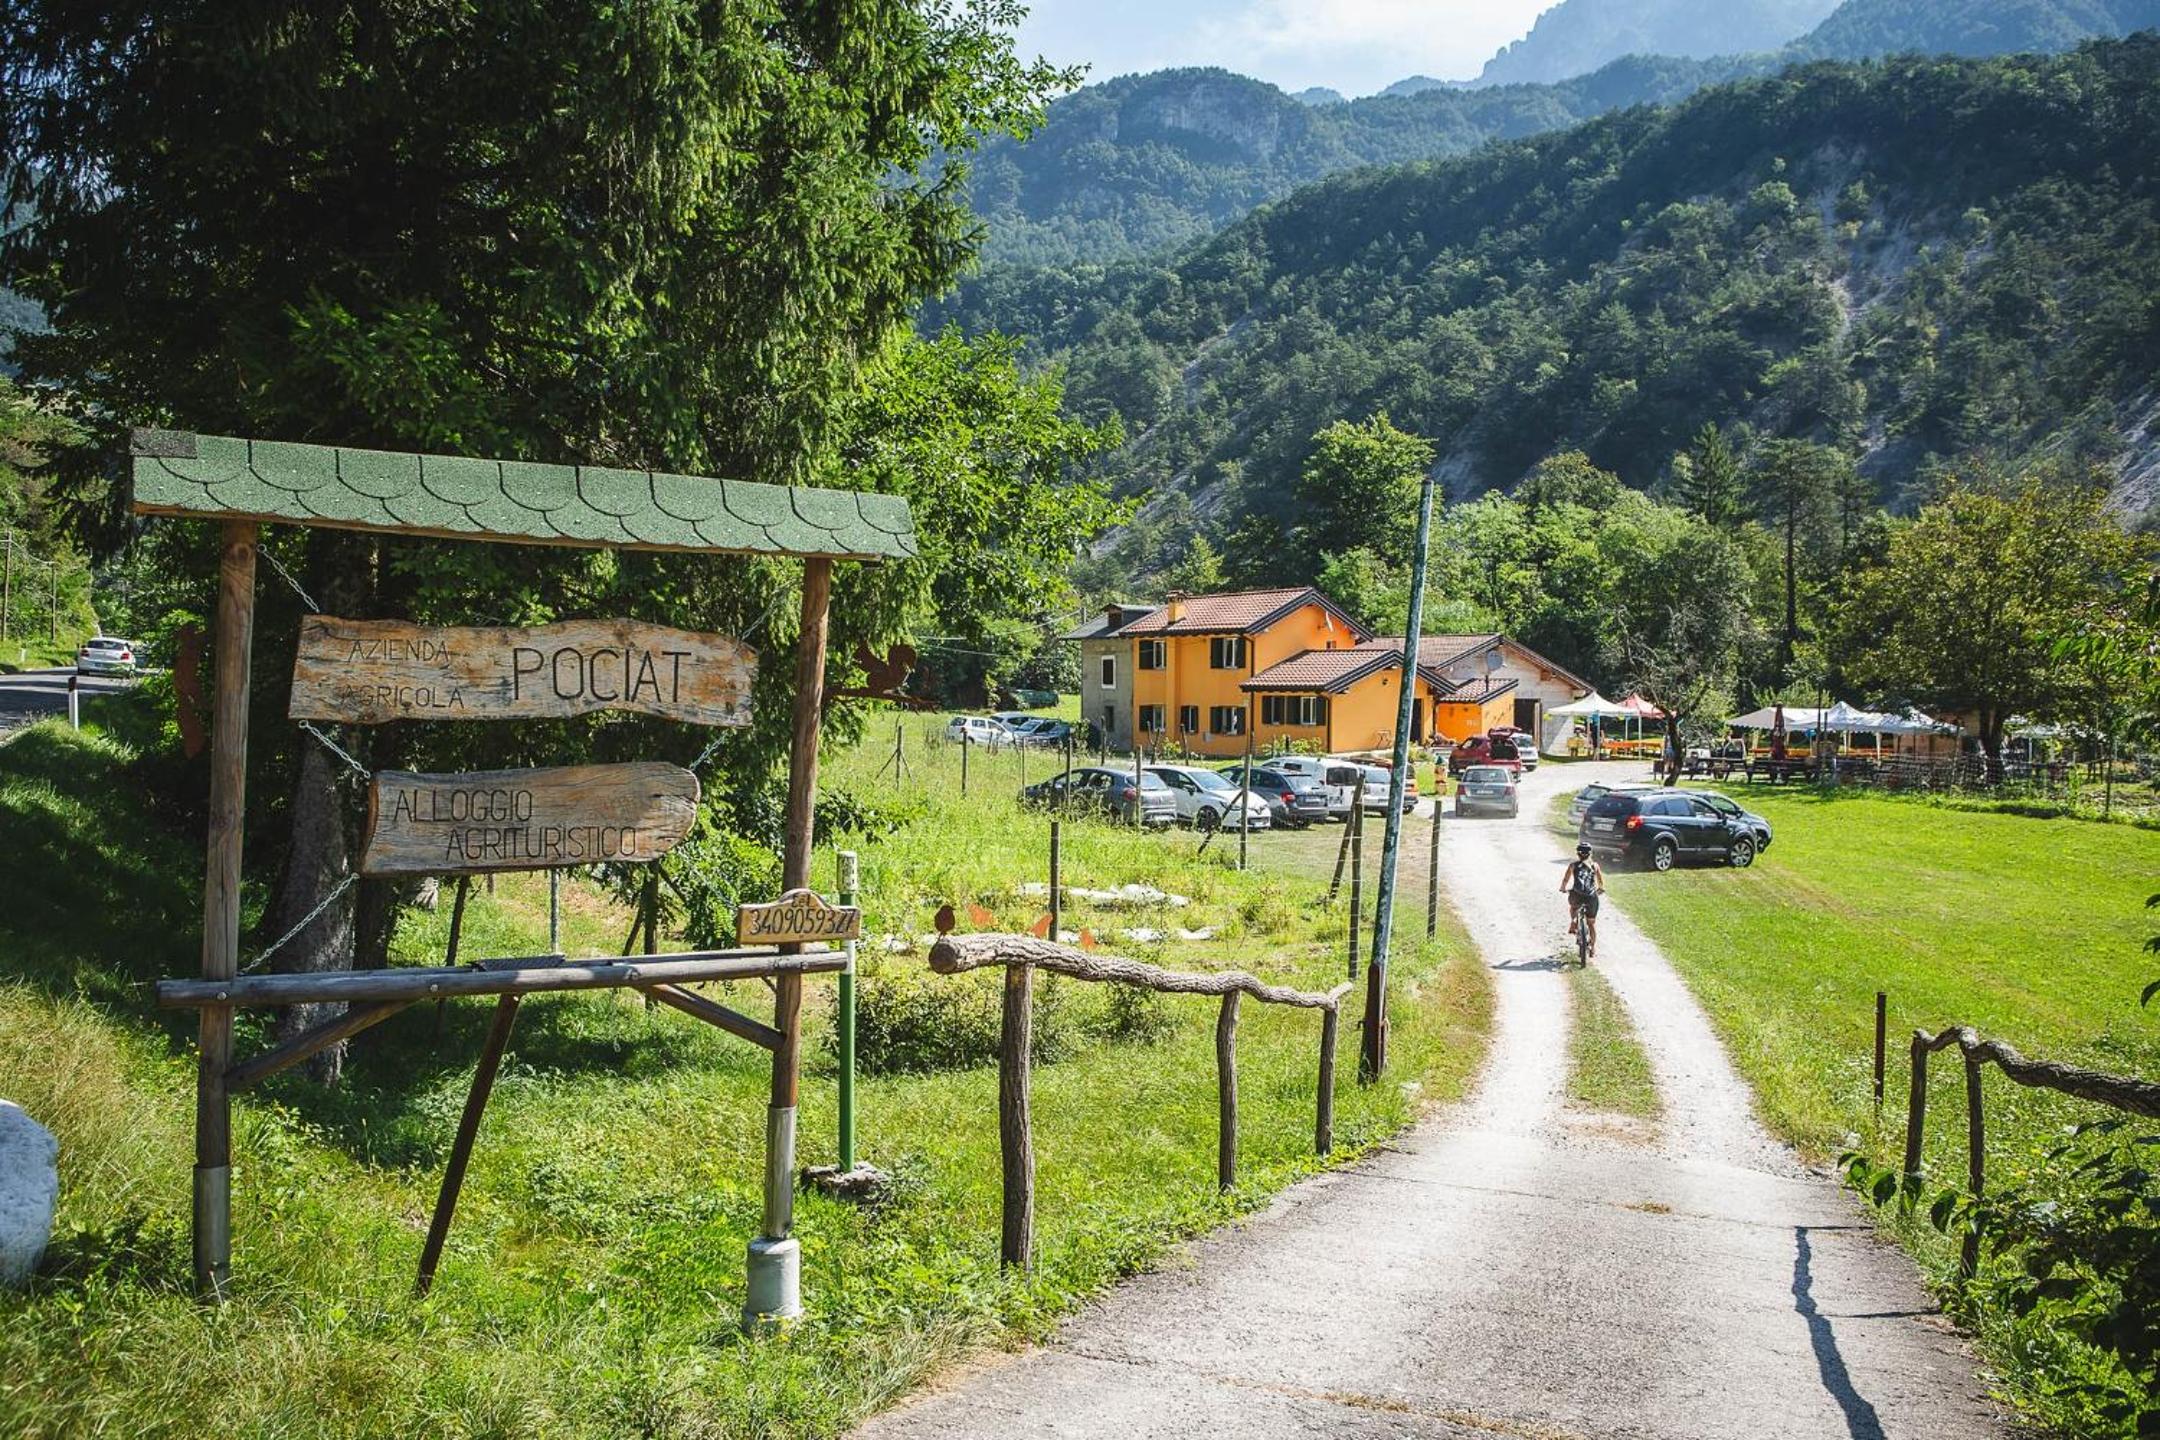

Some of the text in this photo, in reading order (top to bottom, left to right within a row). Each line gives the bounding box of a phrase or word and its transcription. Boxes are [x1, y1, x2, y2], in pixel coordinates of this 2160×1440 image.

[349, 639, 451, 663] AZIENDA
[513, 646, 692, 703] POCIAT
[340, 684, 465, 709] AGRICOLA
[394, 789, 533, 823] ALLOGGIO
[446, 826, 636, 861] AGRITURISTICO
